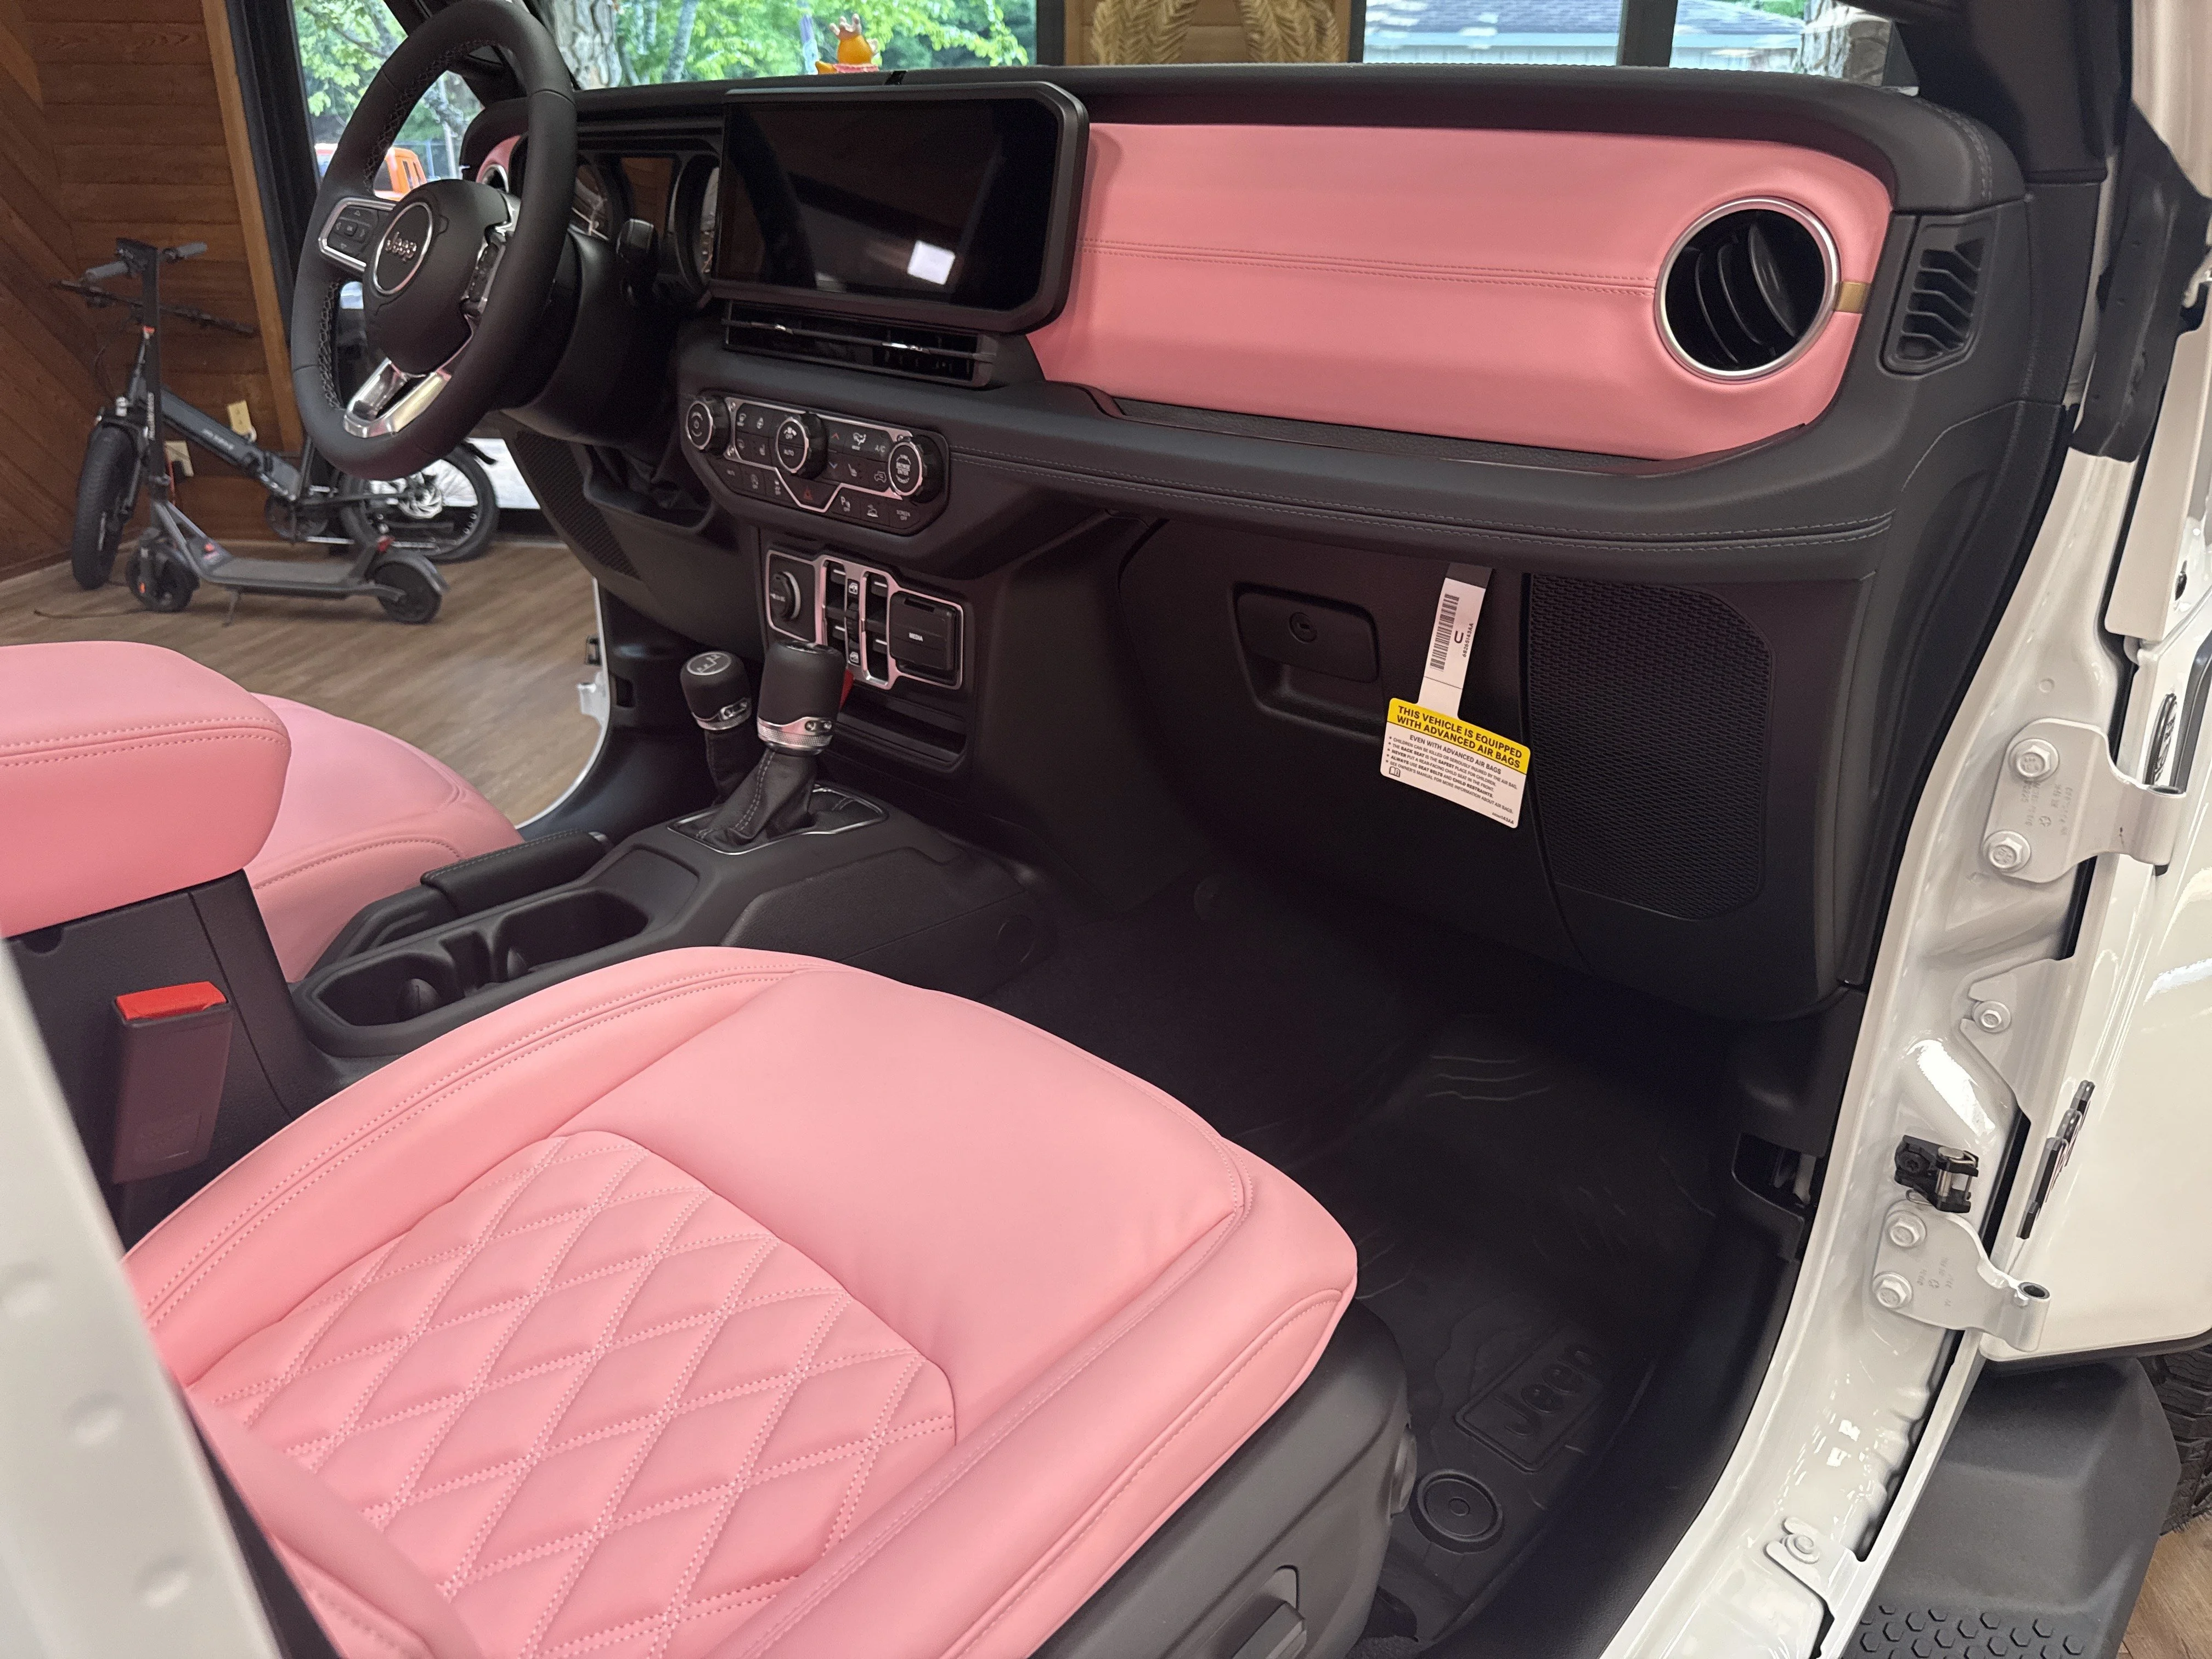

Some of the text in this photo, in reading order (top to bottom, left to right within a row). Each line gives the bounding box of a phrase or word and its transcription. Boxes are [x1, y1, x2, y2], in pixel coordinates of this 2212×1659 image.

[385, 232, 417, 262] Jeep
[1397, 715, 1520, 768] WITH ADVANCED AIR BAGS
[1398, 705, 1522, 758] THIS VEHICLE IS EQUIPPED
[1391, 755, 1409, 765] ALWAYS
[1393, 738, 1413, 747] CHILDREN
[1449, 758, 1470, 768] SERIOUSLY
[1471, 766, 1487, 775] INJURED
[1410, 735, 1501, 774] EVEN WITH ADVANCED AIR BAGS
[1419, 759, 1444, 771] REAR-FACING
[1438, 759, 1455, 769] SAFEST
[1417, 770, 1432, 780] MANUAL
[1454, 785, 1481, 798] INFORMATION
[1481, 797, 1494, 805] ABOUT
